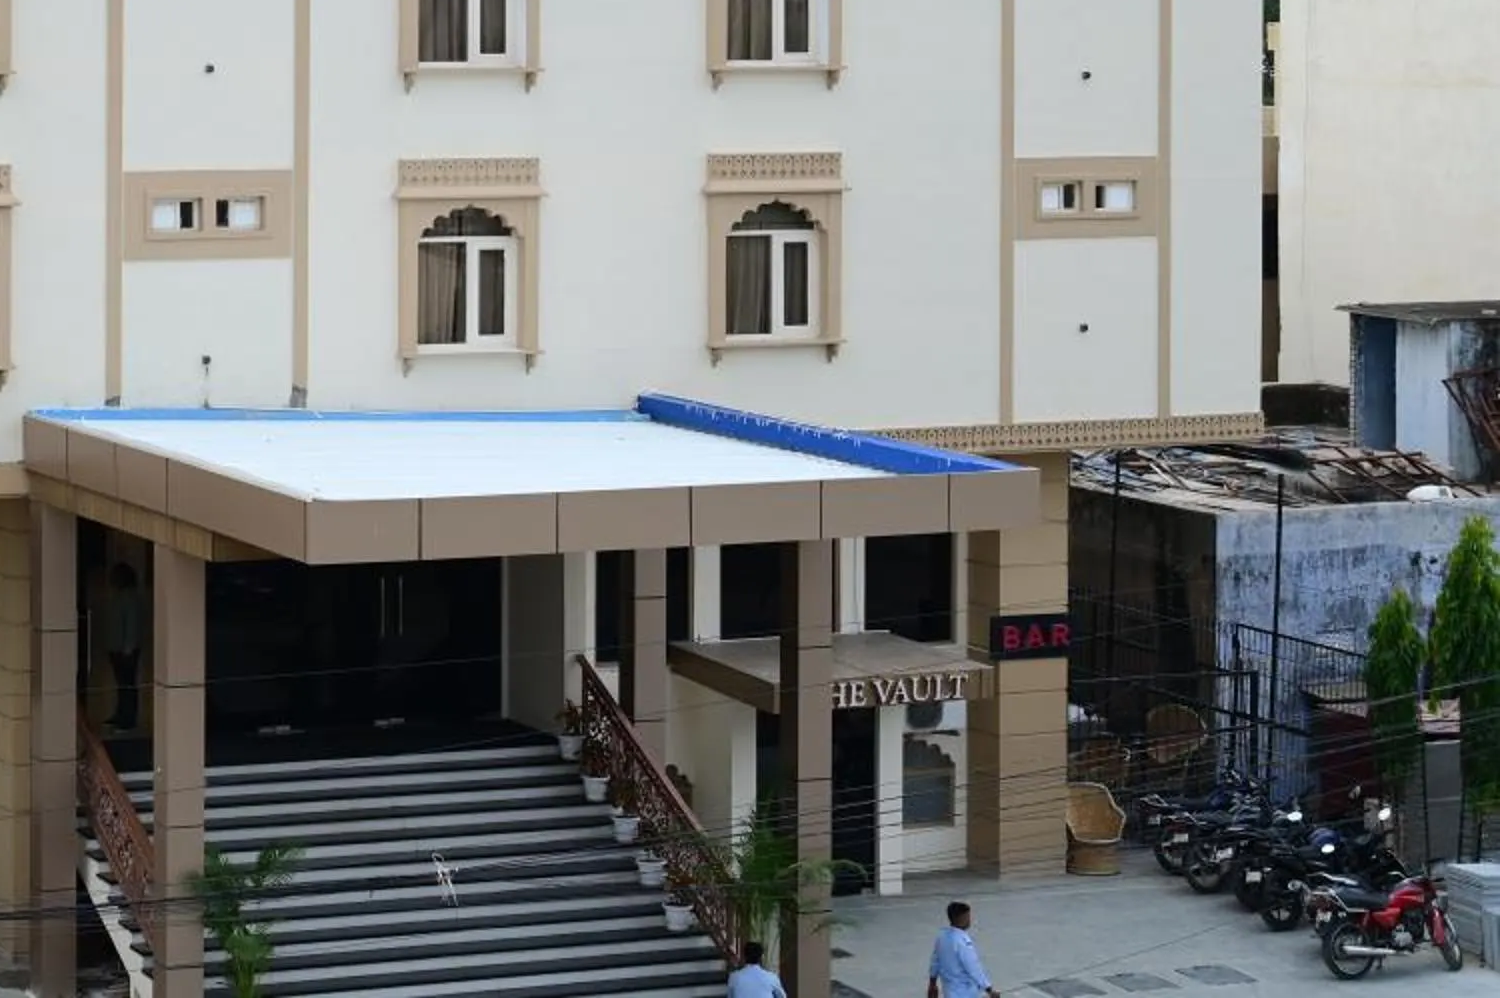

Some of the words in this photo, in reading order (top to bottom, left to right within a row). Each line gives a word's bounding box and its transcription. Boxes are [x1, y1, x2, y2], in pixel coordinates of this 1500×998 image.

[1002, 623, 1071, 651] BAR
[831, 681, 867, 708] HE
[871, 672, 969, 705] VAULT
